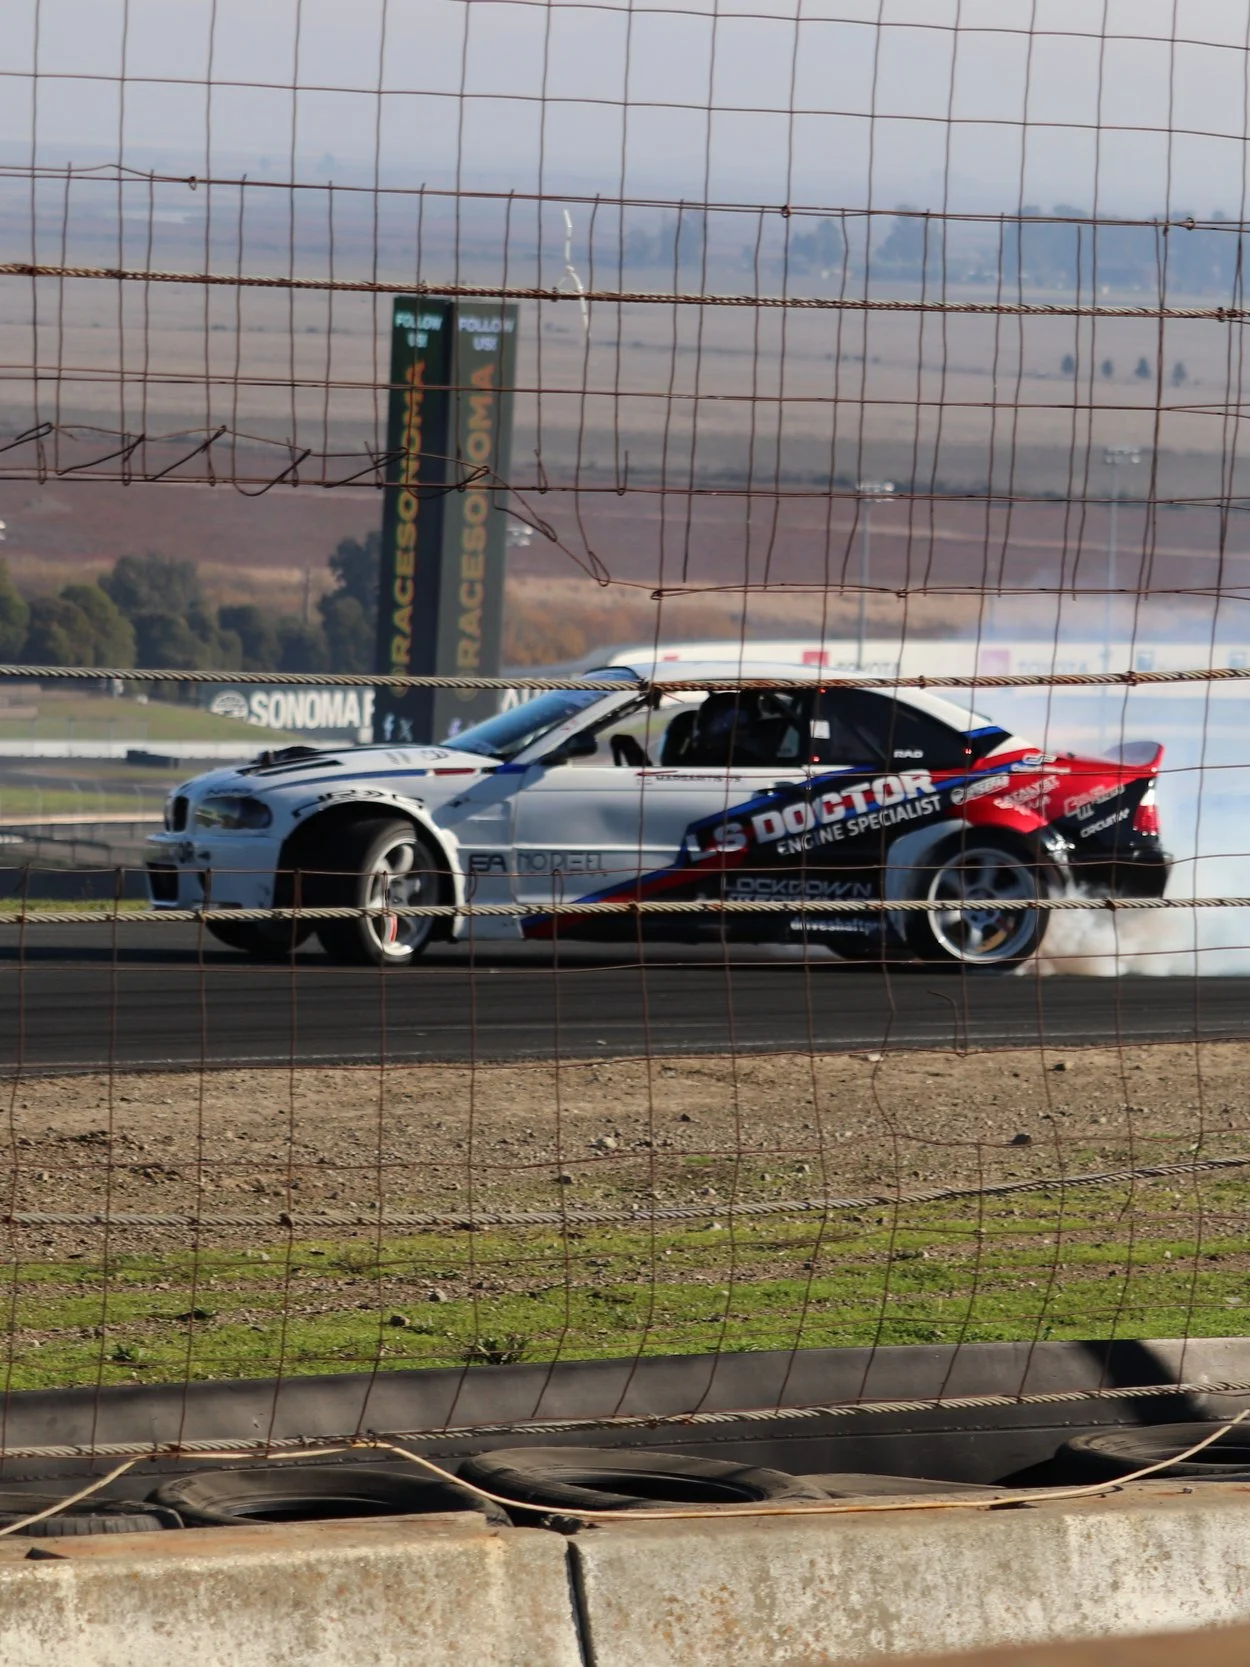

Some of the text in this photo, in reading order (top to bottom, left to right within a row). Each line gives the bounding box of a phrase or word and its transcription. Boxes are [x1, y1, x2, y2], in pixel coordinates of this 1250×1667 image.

[458, 315, 515, 333] FOLLOW
[249, 689, 361, 729] SONOMA
[752, 768, 937, 845] DOCTOR
[776, 794, 942, 857] ENGINE SPECIALIST
[722, 877, 872, 897] LOCKDOWN
